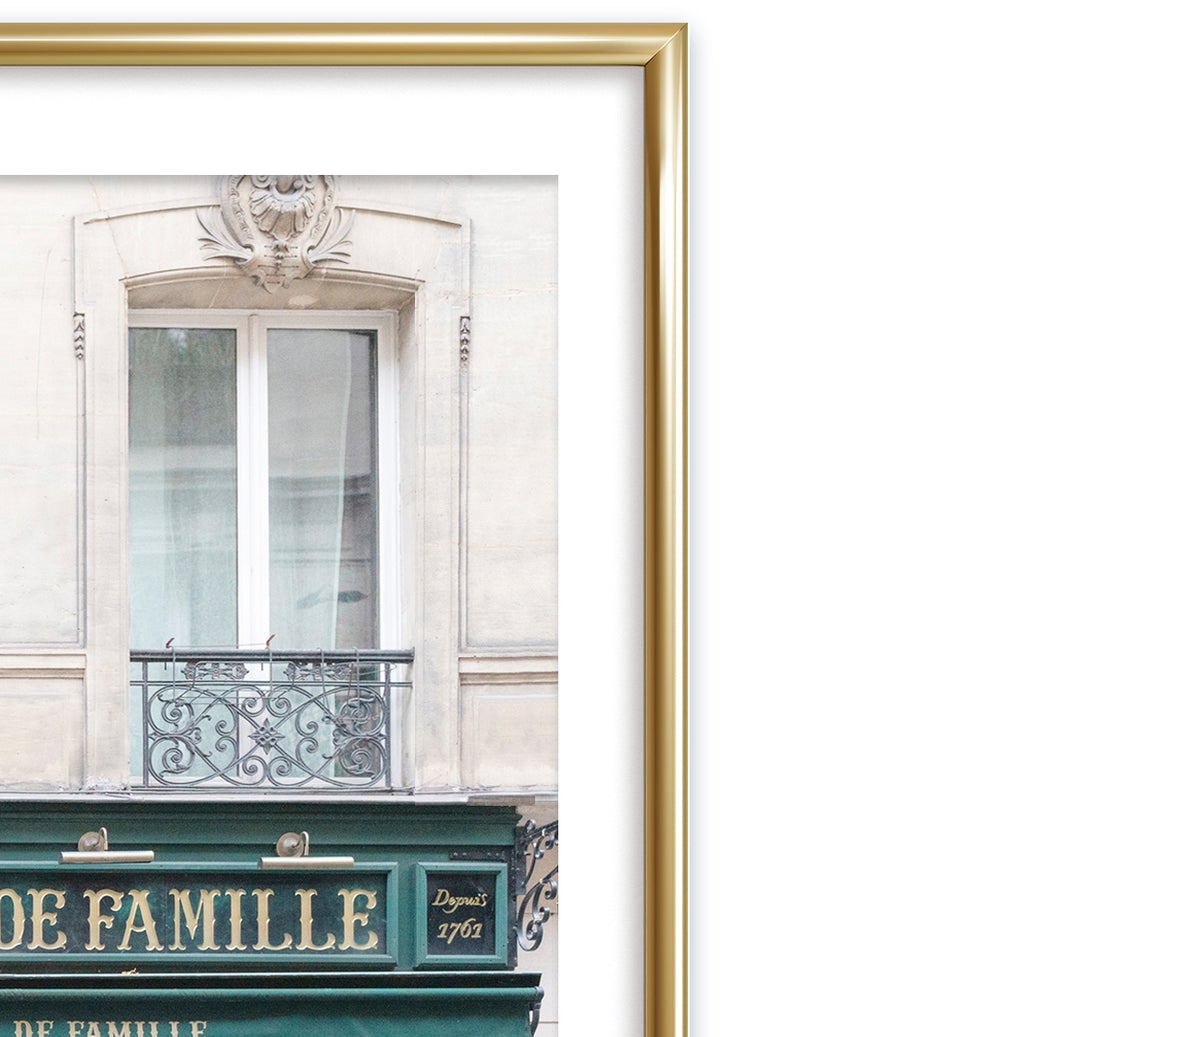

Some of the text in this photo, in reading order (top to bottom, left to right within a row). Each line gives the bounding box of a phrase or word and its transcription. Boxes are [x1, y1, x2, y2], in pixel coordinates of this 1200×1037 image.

[432, 889, 488, 914] Depuis
[82, 888, 379, 952] FAMILLE
[437, 918, 483, 944] 1761
